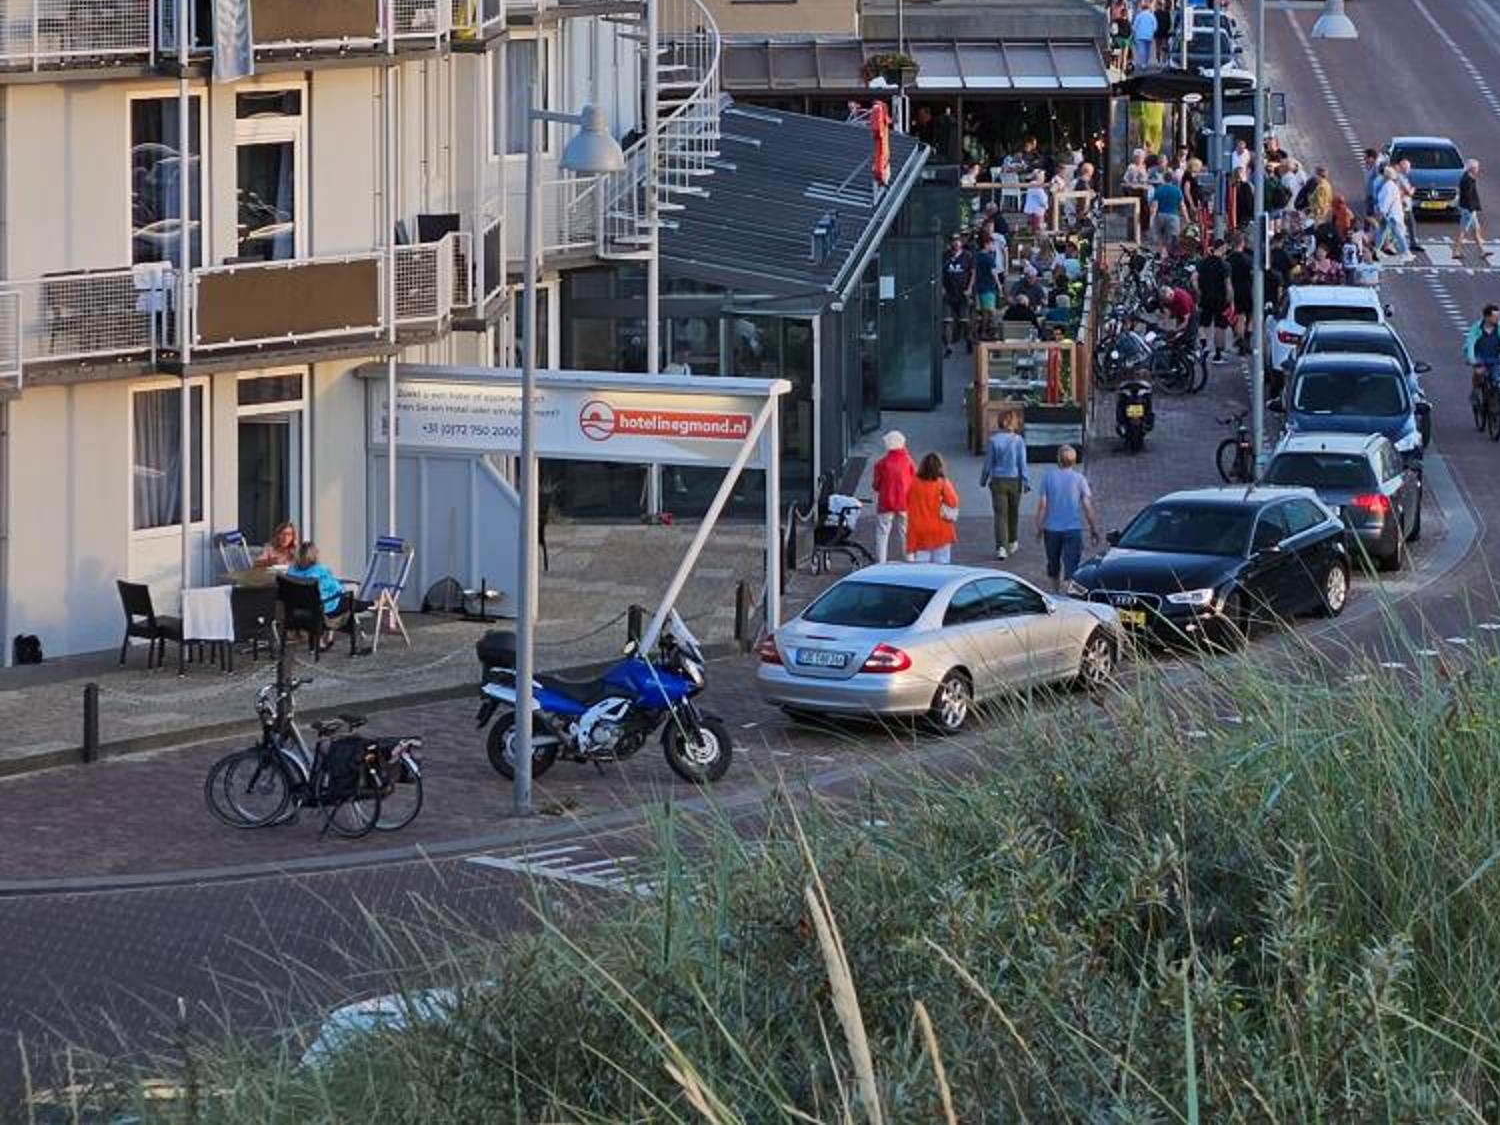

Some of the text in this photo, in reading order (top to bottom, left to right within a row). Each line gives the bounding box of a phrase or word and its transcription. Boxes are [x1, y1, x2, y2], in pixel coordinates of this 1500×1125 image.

[422, 424, 438, 435] +31
[470, 425, 489, 436] 750
[492, 426, 520, 437] 2000
[619, 414, 747, 436] hotelinegmond.nl
